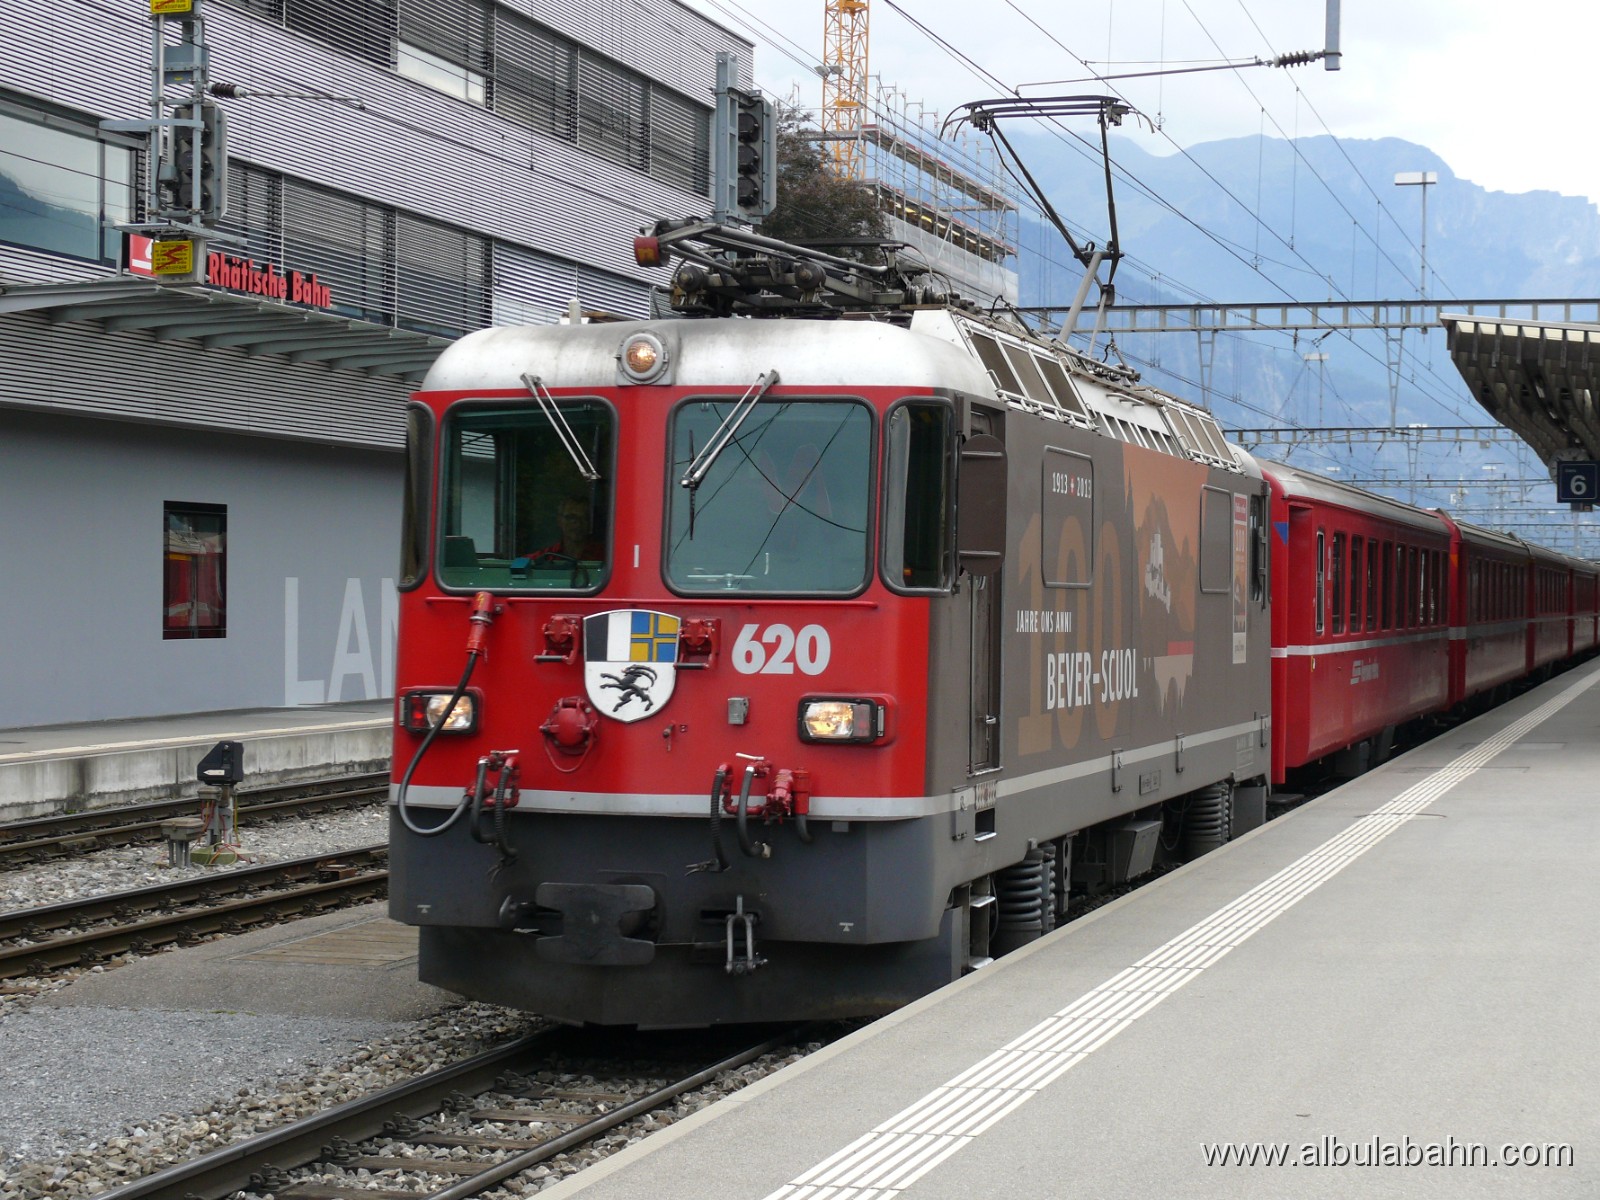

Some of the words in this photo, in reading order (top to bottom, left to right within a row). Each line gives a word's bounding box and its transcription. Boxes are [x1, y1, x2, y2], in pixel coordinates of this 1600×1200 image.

[209, 252, 287, 299] Rhätische
[292, 270, 331, 308] Bahn
[1052, 472, 1068, 494] 1913
[1077, 477, 1092, 499] 2013
[1570, 474, 1588, 496] 6
[1016, 610, 1039, 633] JAHRE
[1056, 611, 1072, 633] ANNI
[1018, 512, 1123, 757] 100
[731, 623, 831, 676] 620
[1047, 648, 1138, 710] BEVER-SCUOL
